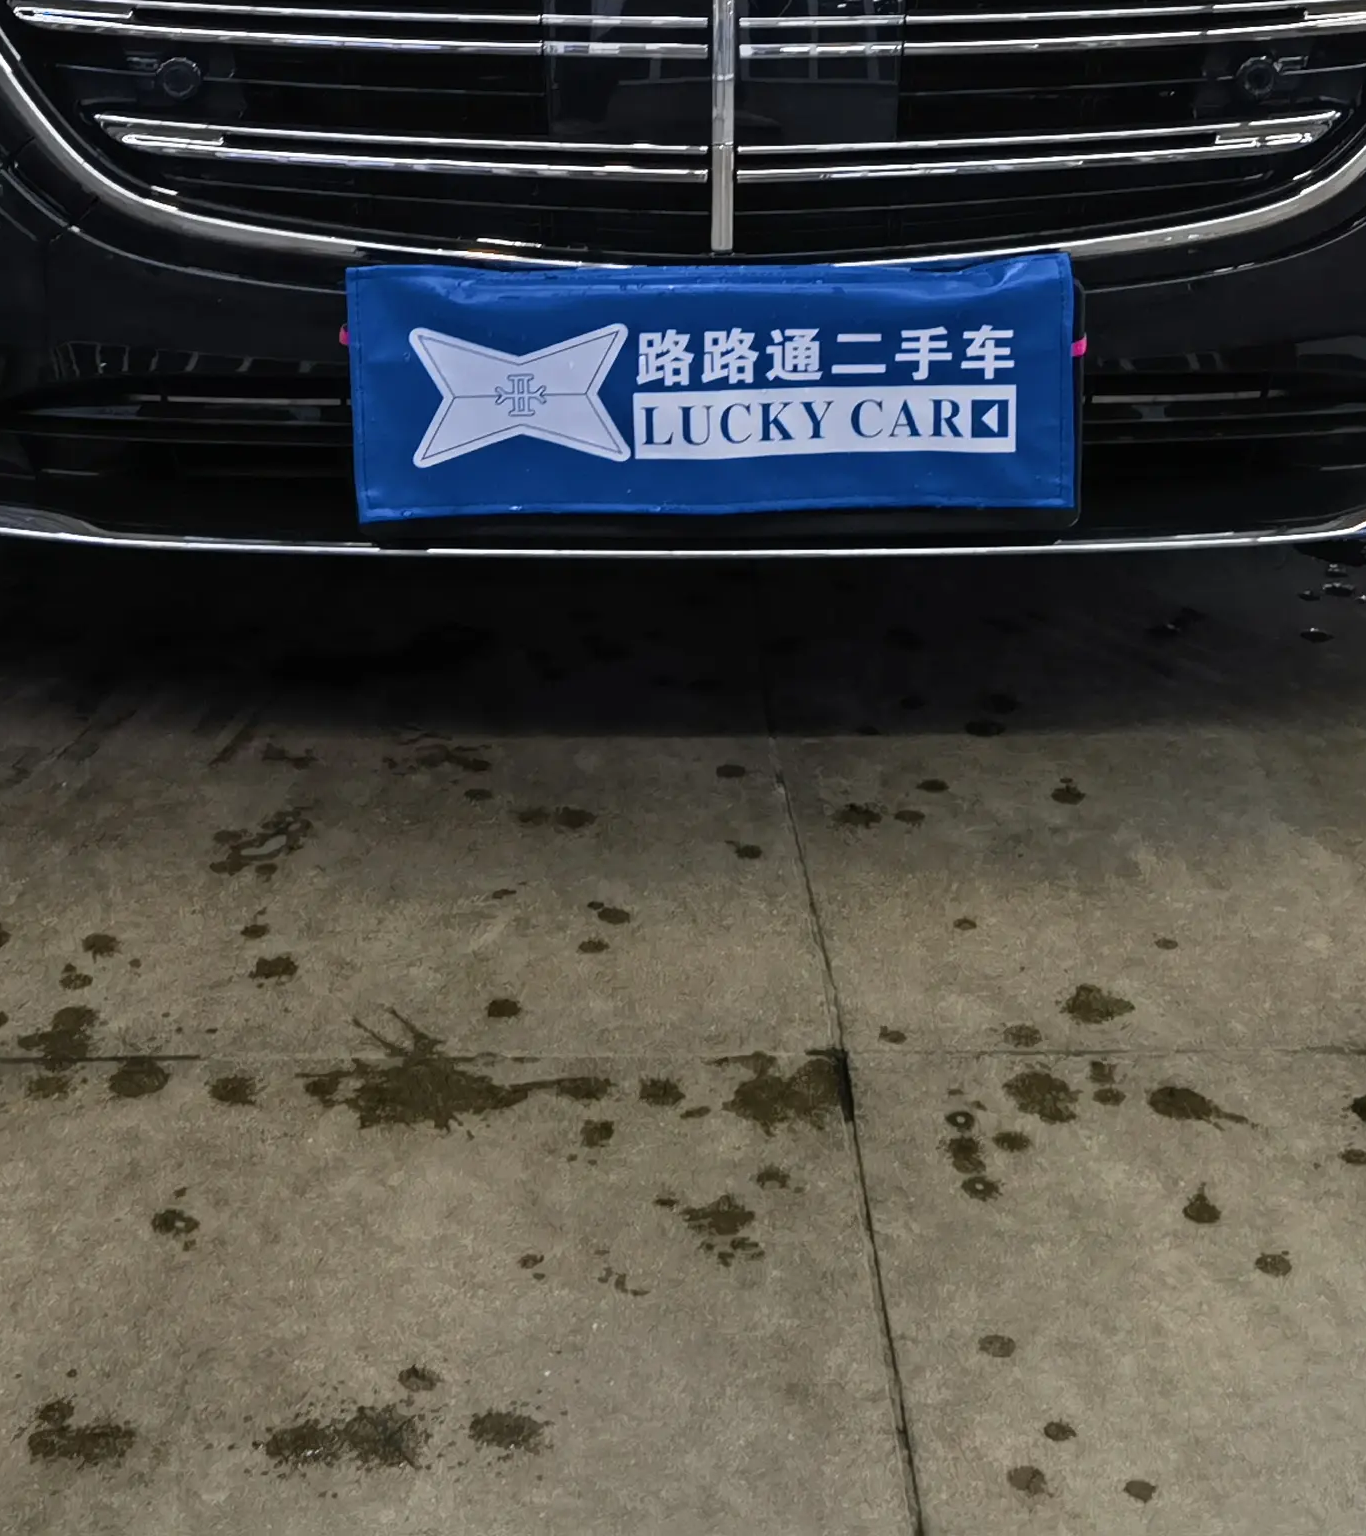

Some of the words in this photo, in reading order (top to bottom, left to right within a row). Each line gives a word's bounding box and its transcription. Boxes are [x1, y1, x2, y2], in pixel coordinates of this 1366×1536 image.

[636, 325, 1016, 386] 路路通二手车
[642, 396, 834, 447] LUCKY
[850, 396, 964, 441] CAR
